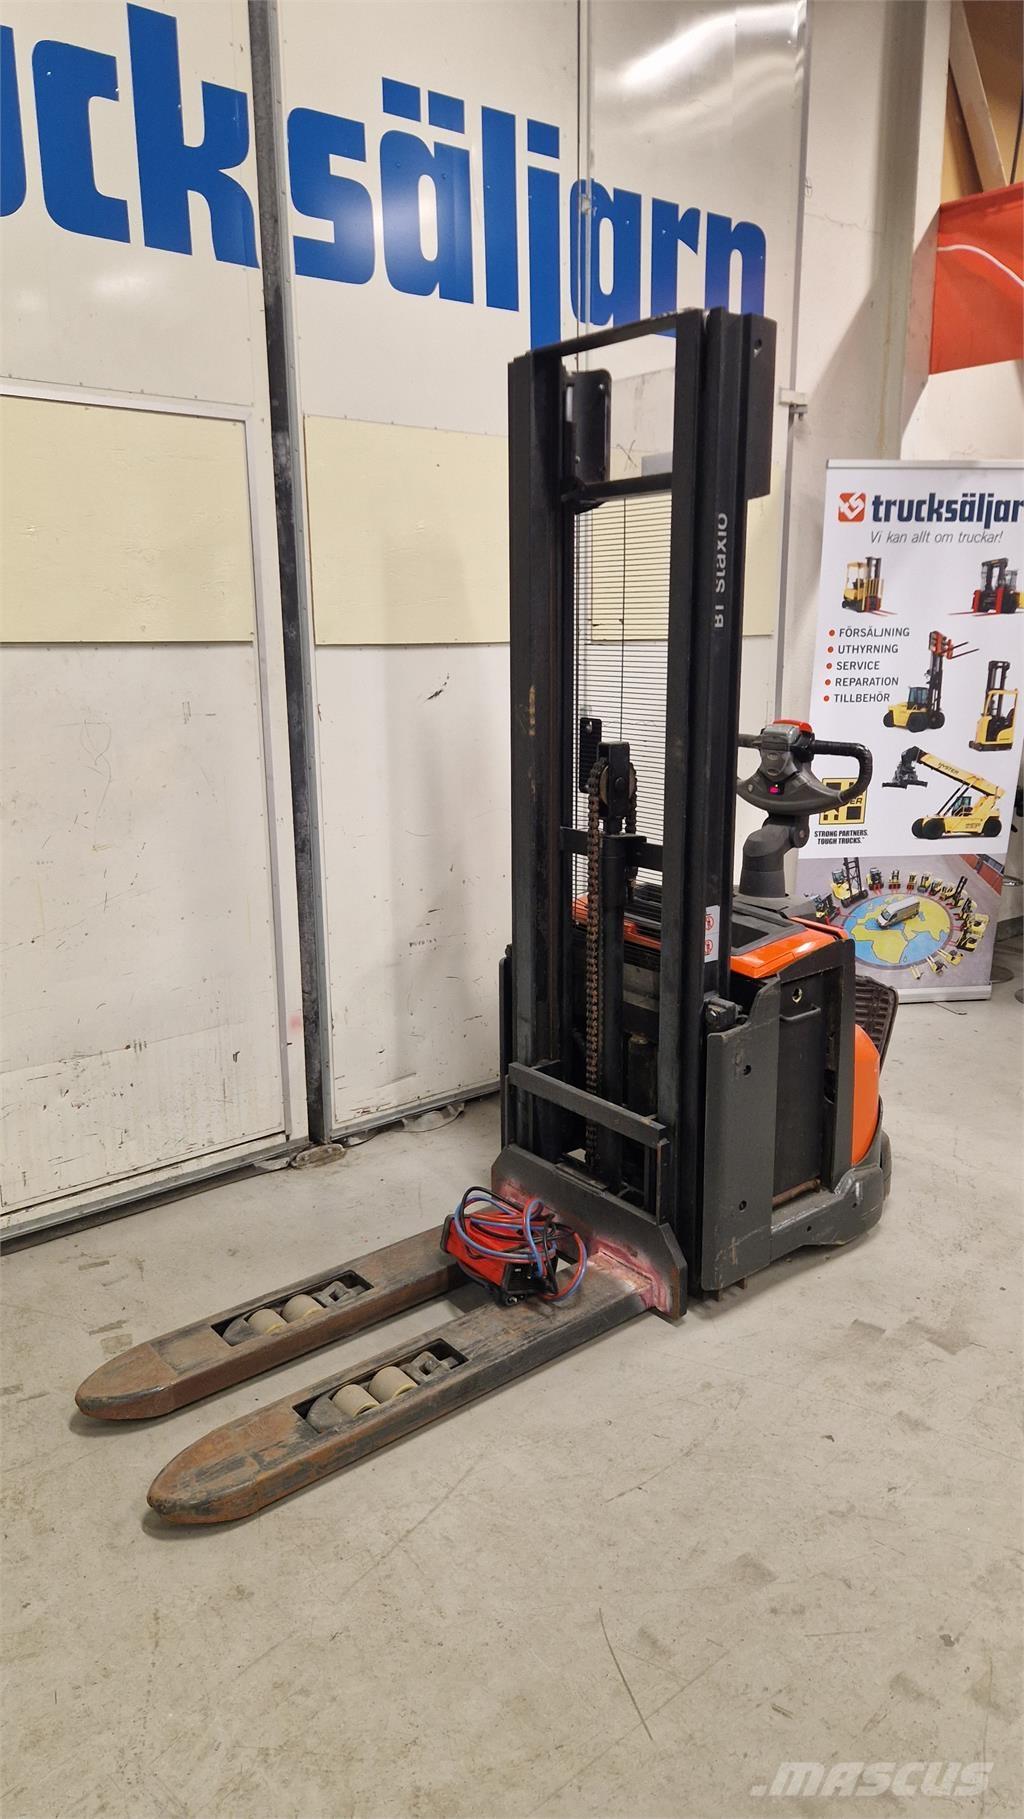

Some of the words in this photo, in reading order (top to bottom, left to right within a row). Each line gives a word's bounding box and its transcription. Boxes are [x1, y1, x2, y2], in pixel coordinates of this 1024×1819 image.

[871, 530, 882, 544] Vi
[886, 530, 908, 544] kan
[911, 530, 931, 544] allt
[934, 533, 954, 544] om
[958, 530, 1004, 544] truckar!
[839, 625, 910, 638] FÖRSÄLJNING
[838, 644, 899, 654] UTHYRNING
[836, 661, 880, 671] SERVICE
[835, 677, 899, 687] REPARATION
[834, 691, 890, 703] TILLBEHÖR
[814, 830, 838, 838] STRONG
